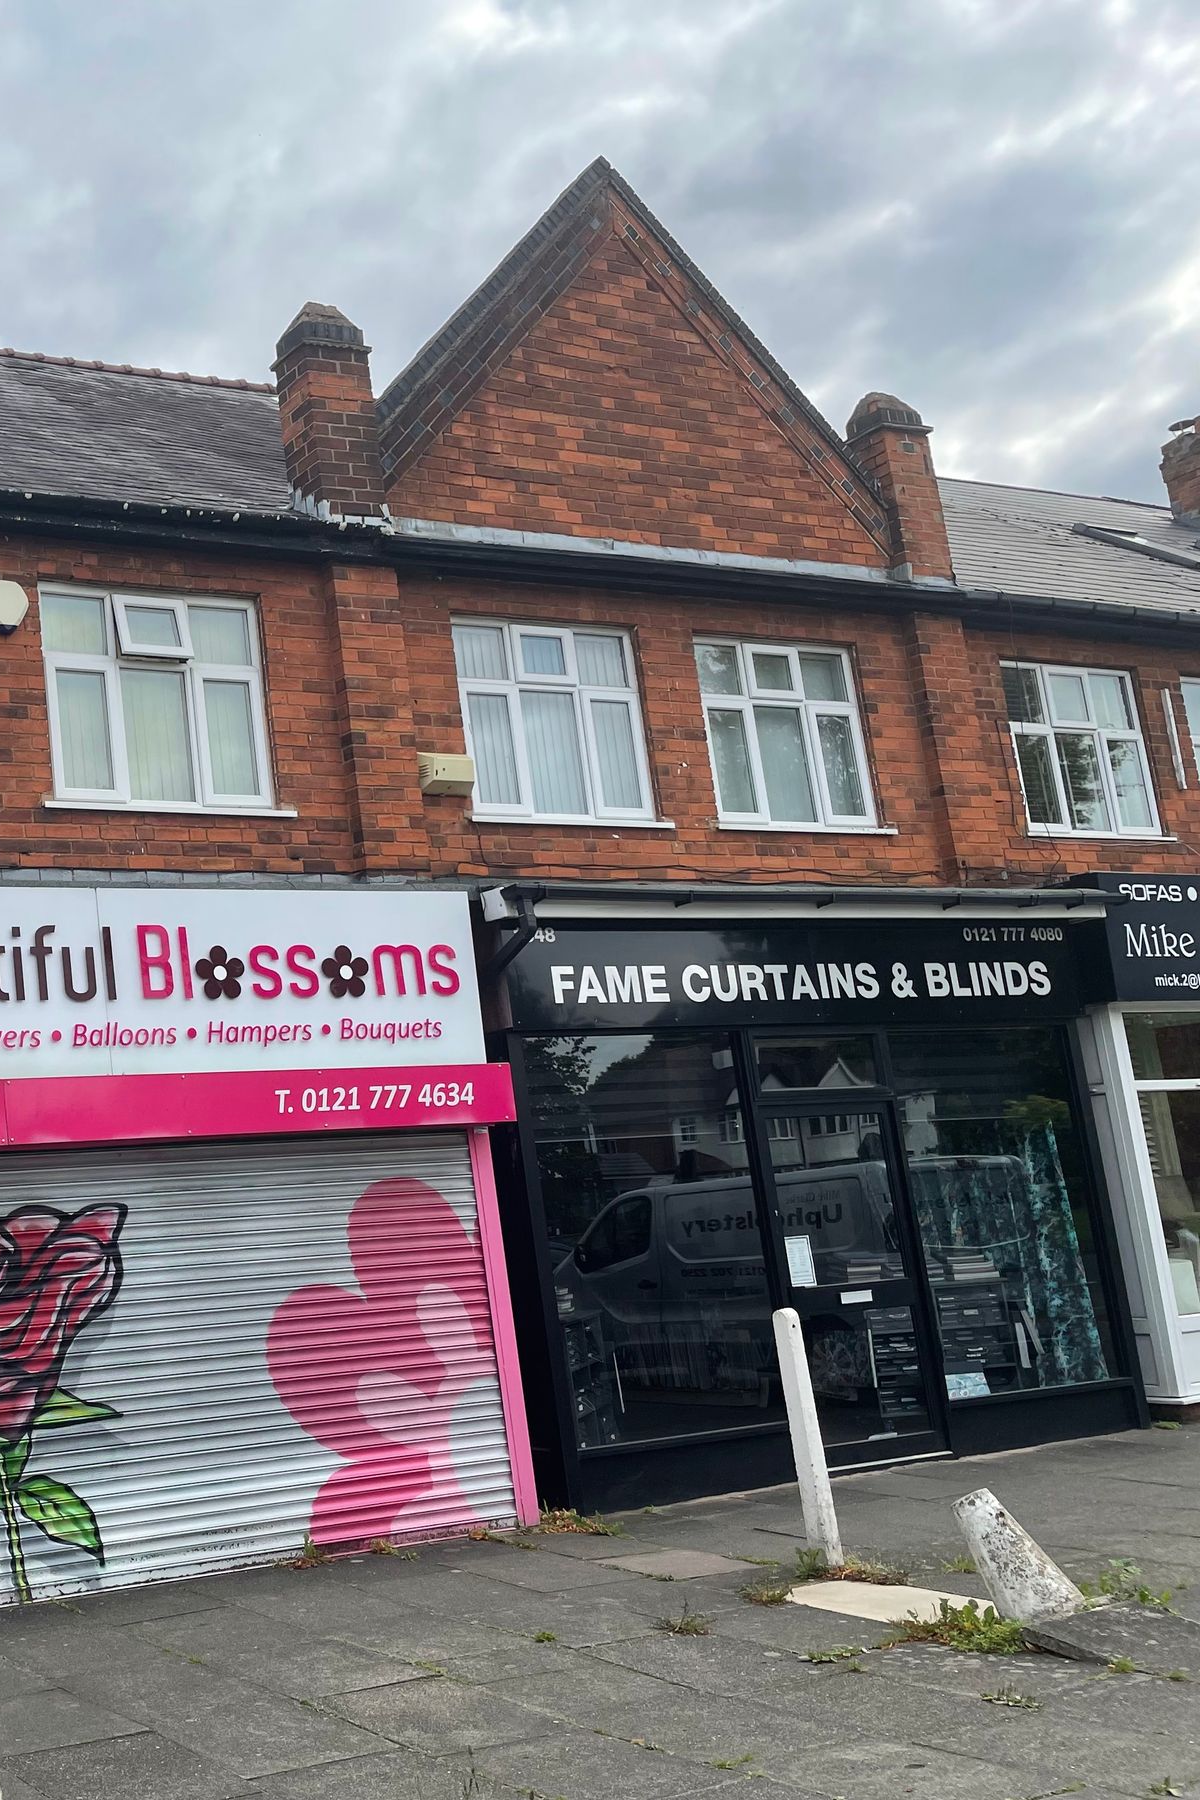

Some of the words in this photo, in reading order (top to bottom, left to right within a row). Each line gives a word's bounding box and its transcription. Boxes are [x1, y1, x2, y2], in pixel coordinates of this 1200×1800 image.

[1118, 883, 1183, 902] SOFAS
[962, 927, 996, 943] 0121
[999, 927, 1027, 943] 777
[1029, 926, 1063, 942] 4080
[1123, 923, 1197, 958] Mike
[550, 964, 671, 1004] FAME
[680, 963, 880, 1002] CURTAINS
[890, 962, 918, 998] &
[923, 961, 1052, 998] BLINDS
[72, 1022, 178, 1047] Balloons
[207, 1018, 313, 1047] Hampers
[340, 1017, 443, 1044] Bouquets
[274, 1089, 295, 1114] T.
[301, 1086, 361, 1113] 0121
[369, 1084, 412, 1110] 777
[418, 1082, 475, 1106] 4634
